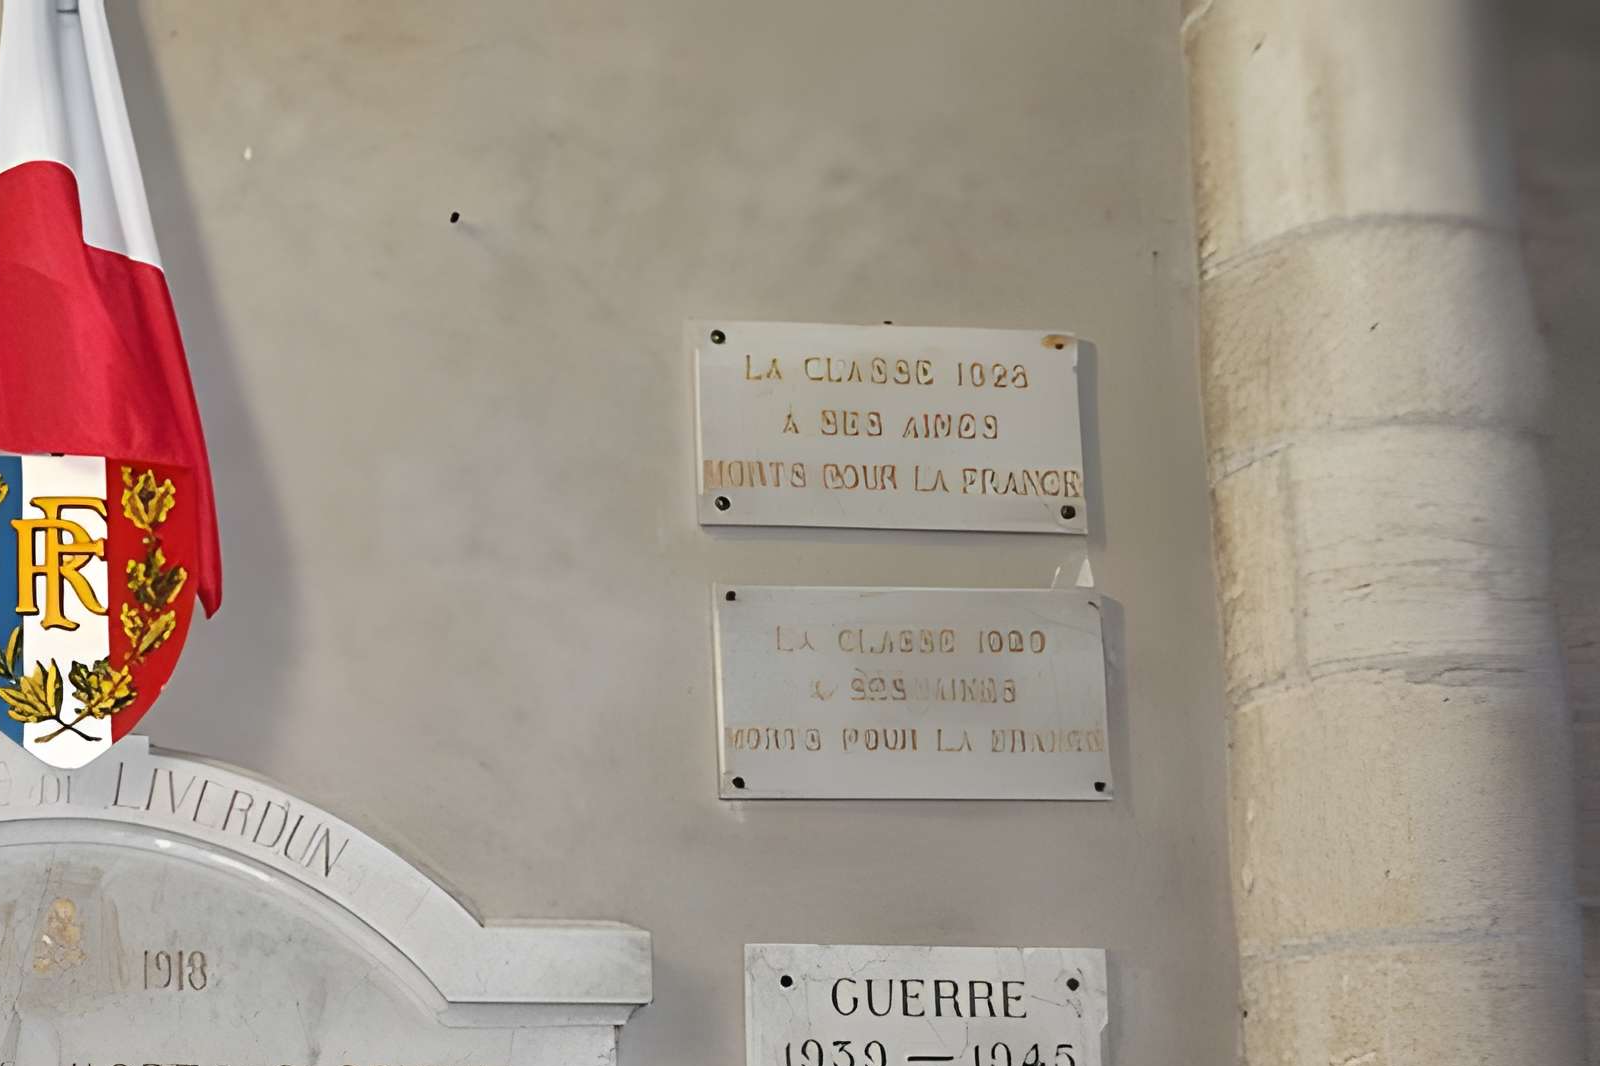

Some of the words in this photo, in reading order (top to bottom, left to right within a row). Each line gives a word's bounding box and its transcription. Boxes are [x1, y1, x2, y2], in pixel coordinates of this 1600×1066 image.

[746, 355, 783, 380] LA
[805, 357, 934, 385] CLASSE
[823, 464, 896, 490] POUR
[915, 466, 950, 492] LA
[963, 469, 1081, 497] FRANCE
[937, 729, 972, 752] LA
[104, 761, 350, 877] LIVERDUN
[144, 950, 207, 991] 1918
[832, 978, 1026, 1018] GUERRE
